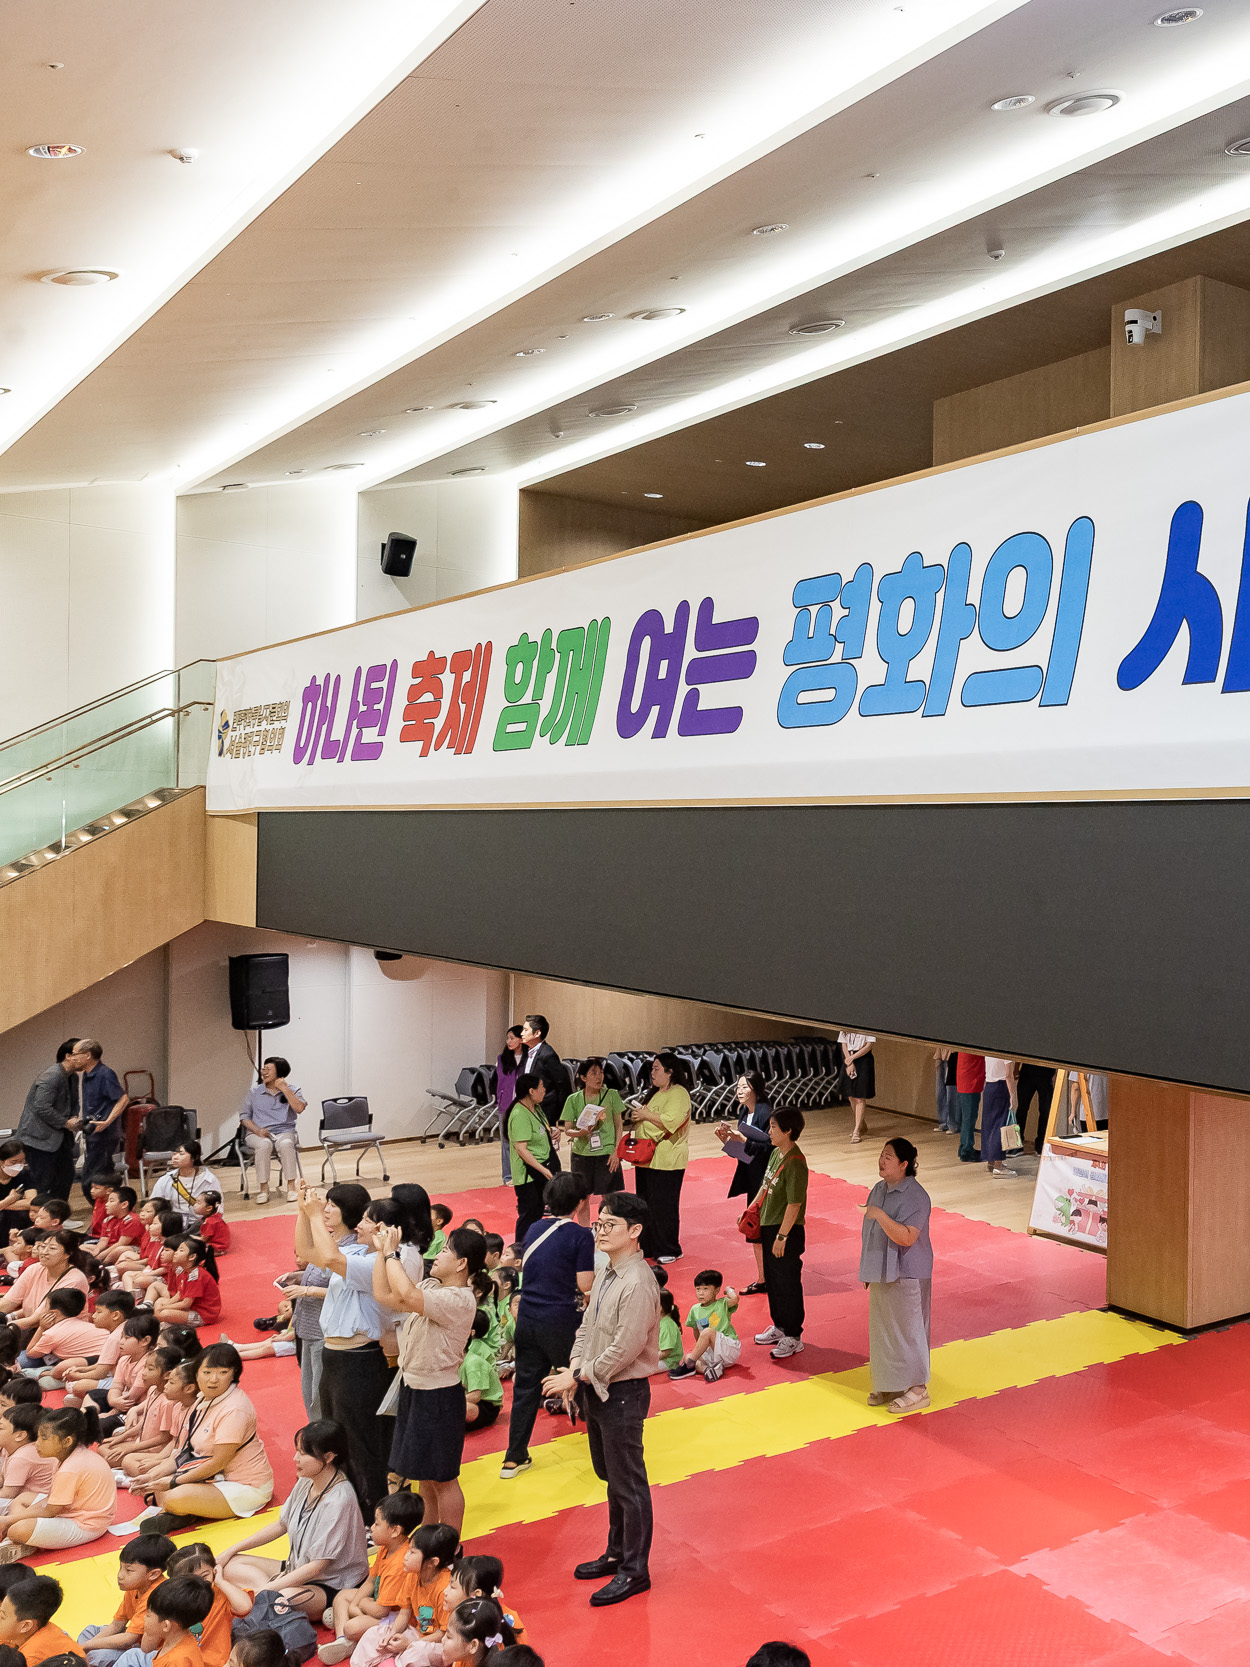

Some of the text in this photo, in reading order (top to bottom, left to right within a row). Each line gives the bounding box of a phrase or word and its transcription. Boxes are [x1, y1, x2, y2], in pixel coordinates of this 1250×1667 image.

[293, 659, 398, 766] 하나된
[400, 641, 492, 758] 축제
[493, 617, 611, 752] 함께
[616, 597, 760, 740] 여는
[777, 516, 1096, 730] 평화의
[225, 726, 287, 760] 서울광진구협의회
